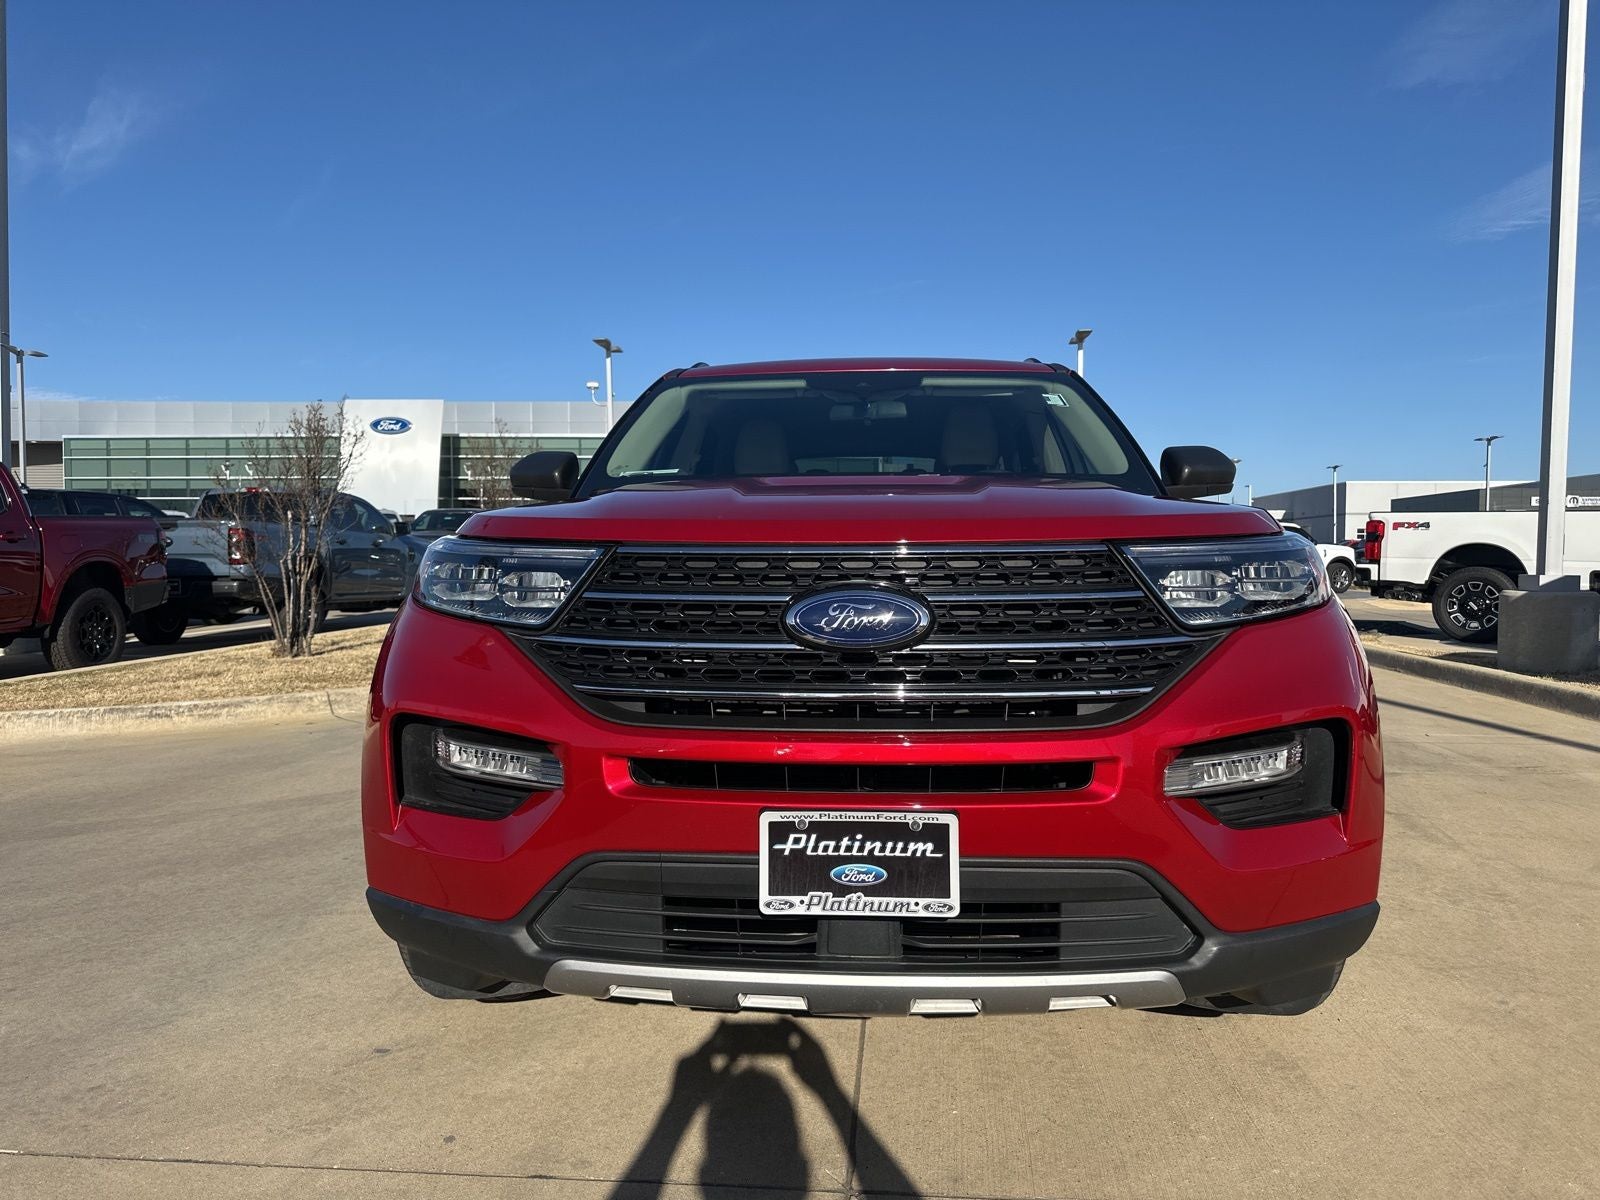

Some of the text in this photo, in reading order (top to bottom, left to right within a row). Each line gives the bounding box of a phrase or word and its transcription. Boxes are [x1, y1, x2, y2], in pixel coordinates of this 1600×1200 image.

[377, 420, 402, 430] Ford
[1392, 521, 1430, 531] FX4
[814, 602, 895, 631] Ford
[779, 812, 939, 822] www.PlatinumFord.com
[773, 833, 943, 857] Platinum
[841, 865, 876, 882] Ford
[804, 893, 919, 913] Platinum
